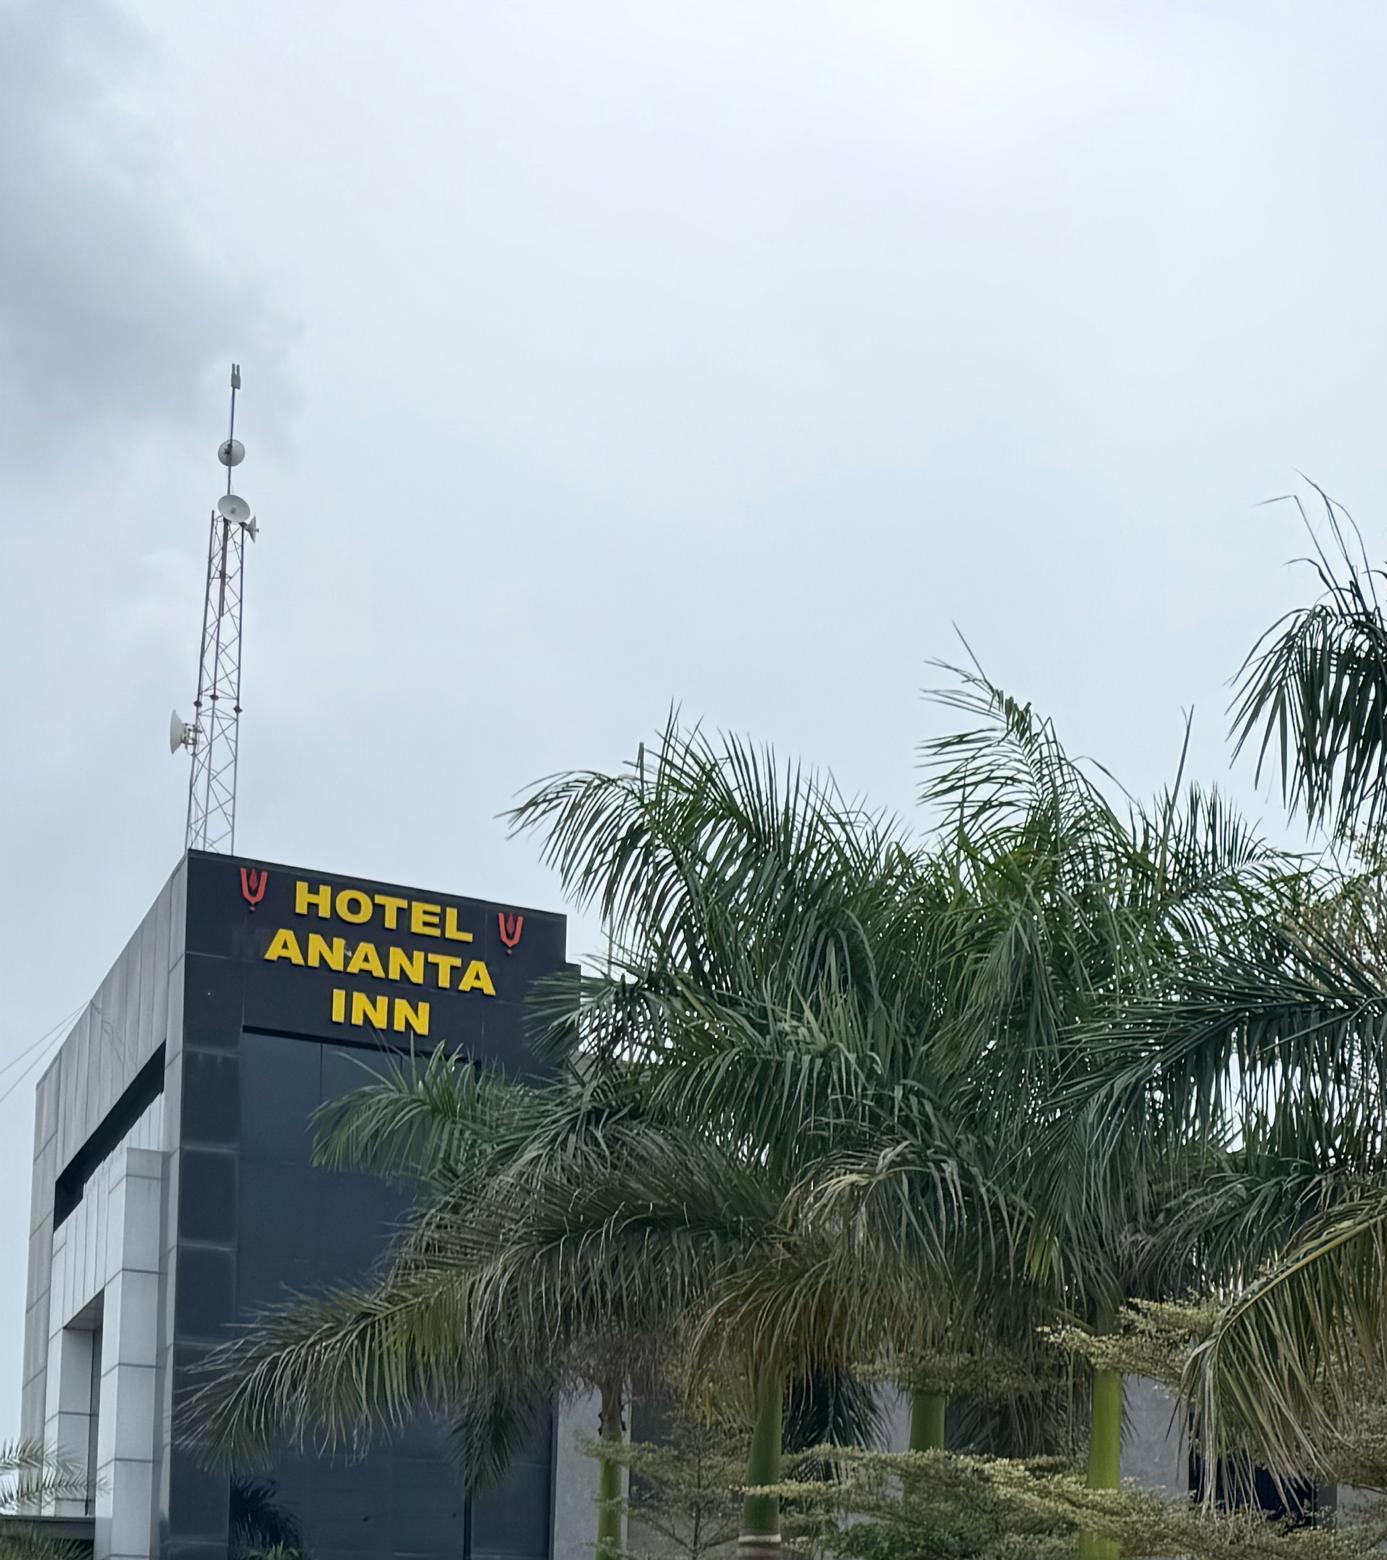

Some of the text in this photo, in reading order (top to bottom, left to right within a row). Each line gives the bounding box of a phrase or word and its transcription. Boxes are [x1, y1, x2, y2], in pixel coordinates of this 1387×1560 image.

[294, 880, 474, 943] HOTEL
[263, 928, 497, 997] ANANTA
[331, 988, 431, 1036] INN
